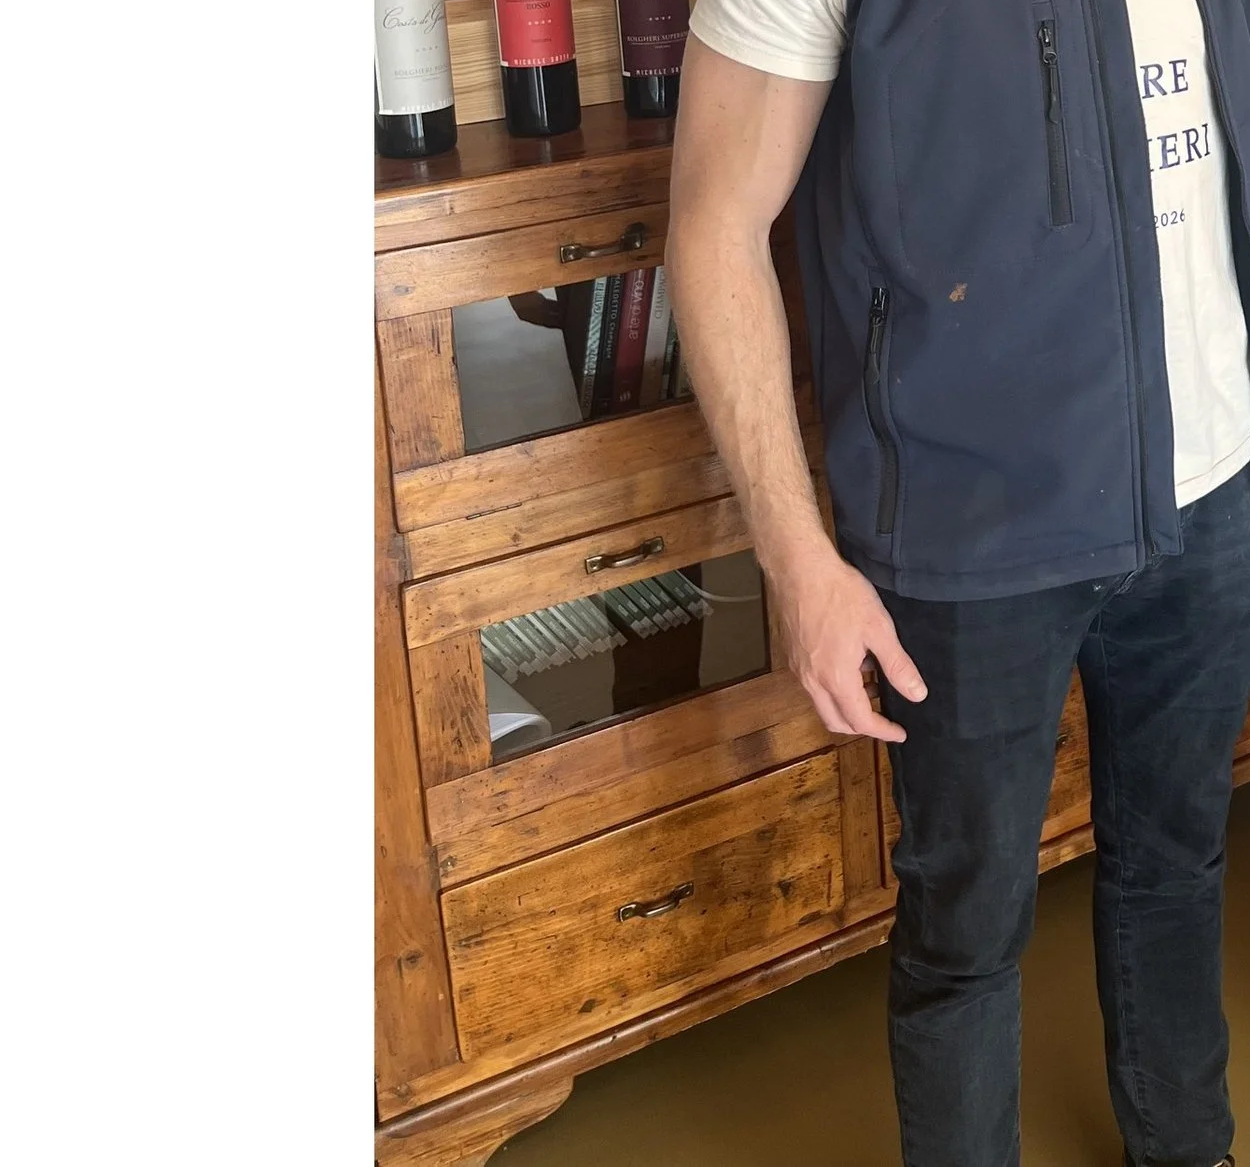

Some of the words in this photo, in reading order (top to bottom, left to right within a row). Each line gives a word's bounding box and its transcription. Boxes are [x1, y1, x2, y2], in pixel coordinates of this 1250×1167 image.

[526, 1, 551, 10] ROSSO
[513, 58, 547, 66] MICHELE
[635, 68, 669, 76] MICHELE
[1139, 59, 1189, 100] RE
[1153, 208, 1186, 229] 2026
[632, 279, 645, 304] vino
[628, 317, 640, 341] arte
